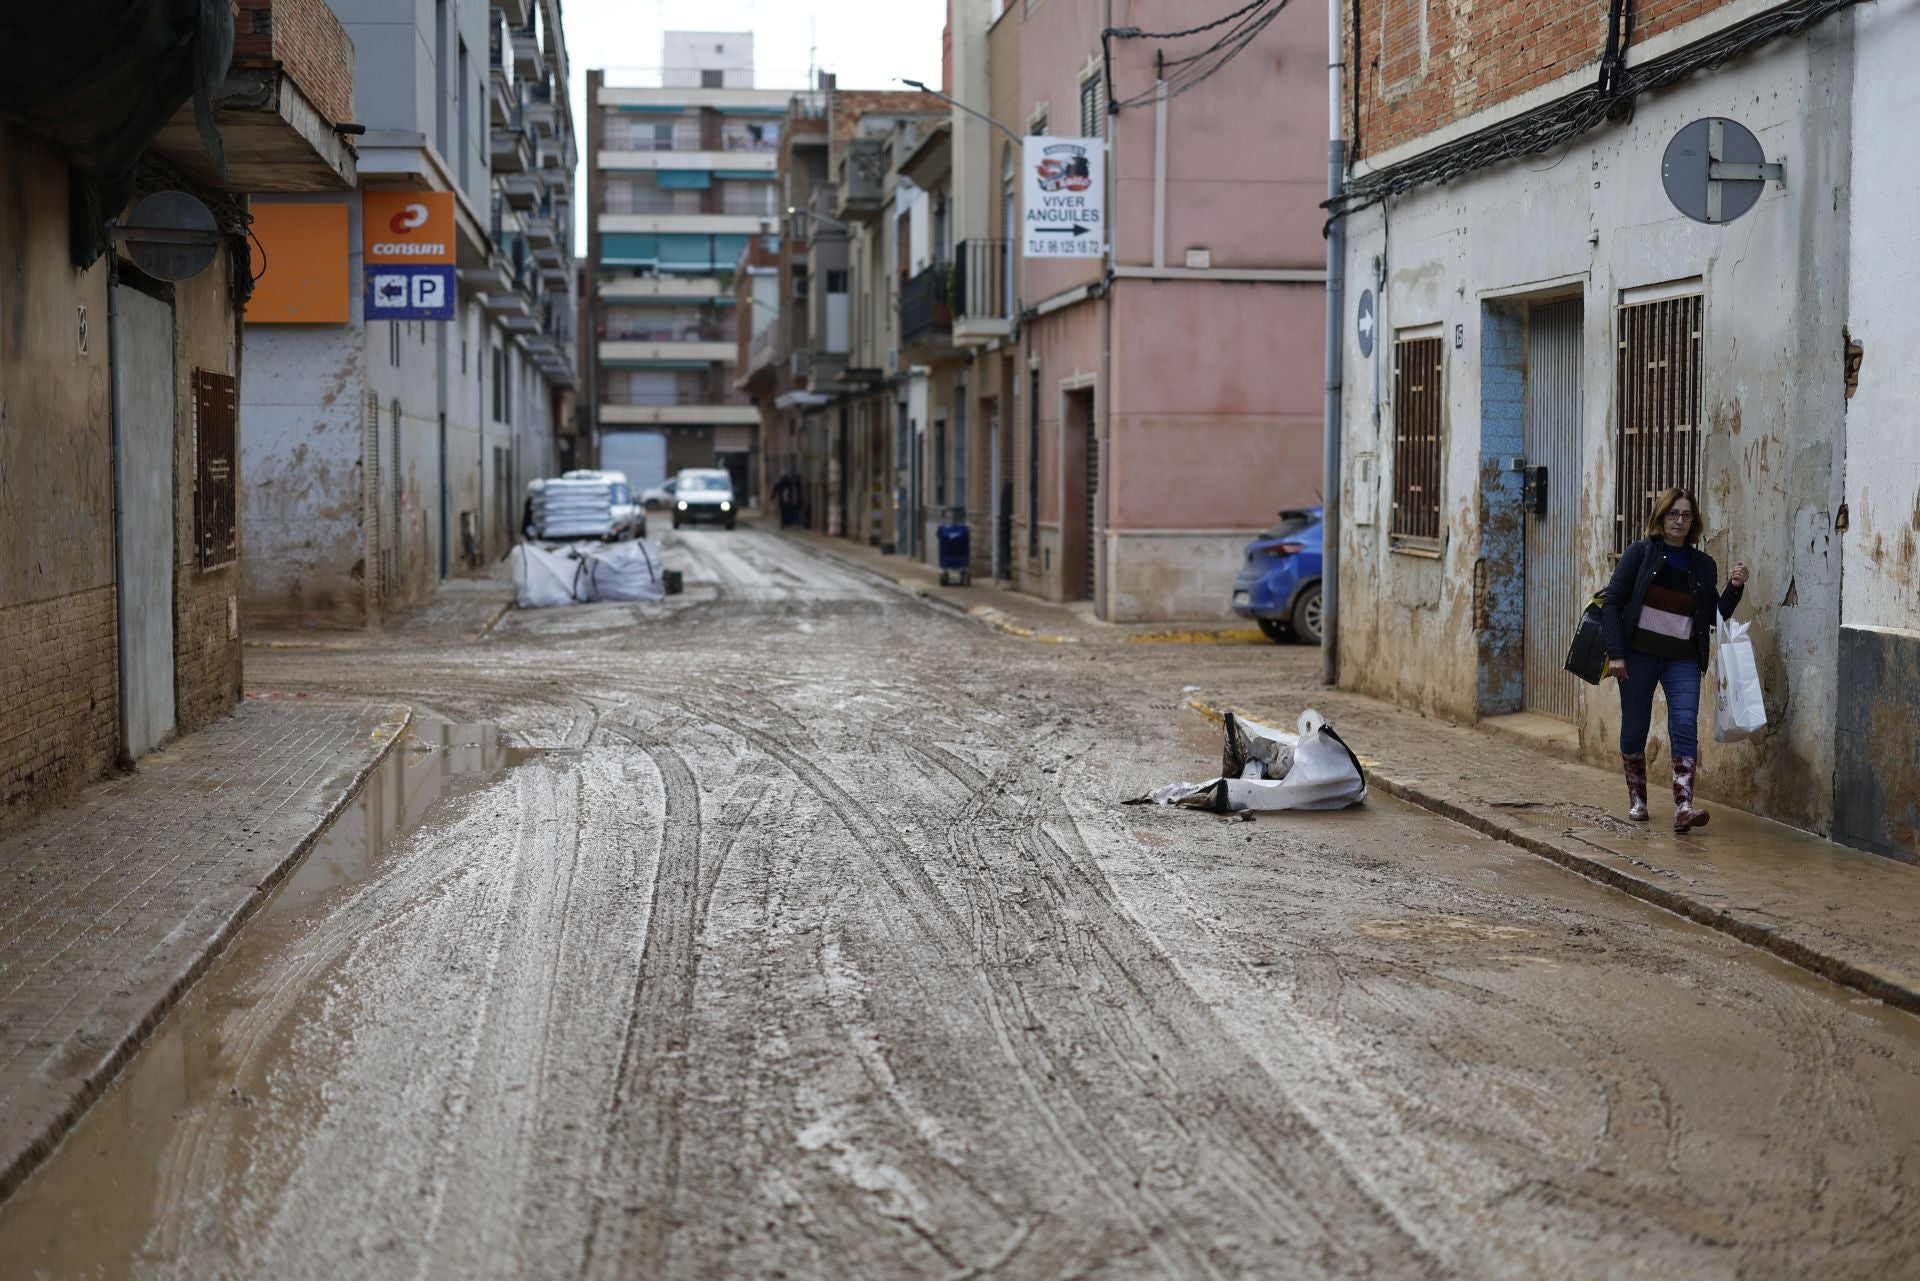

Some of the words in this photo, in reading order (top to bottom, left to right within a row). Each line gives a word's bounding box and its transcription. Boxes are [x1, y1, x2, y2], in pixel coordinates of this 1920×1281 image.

[1043, 196, 1085, 207] VIVER
[1026, 209, 1100, 222] ANGUILES
[372, 242, 446, 255] consum
[1060, 240, 1075, 253] 125
[419, 279, 436, 303] P
